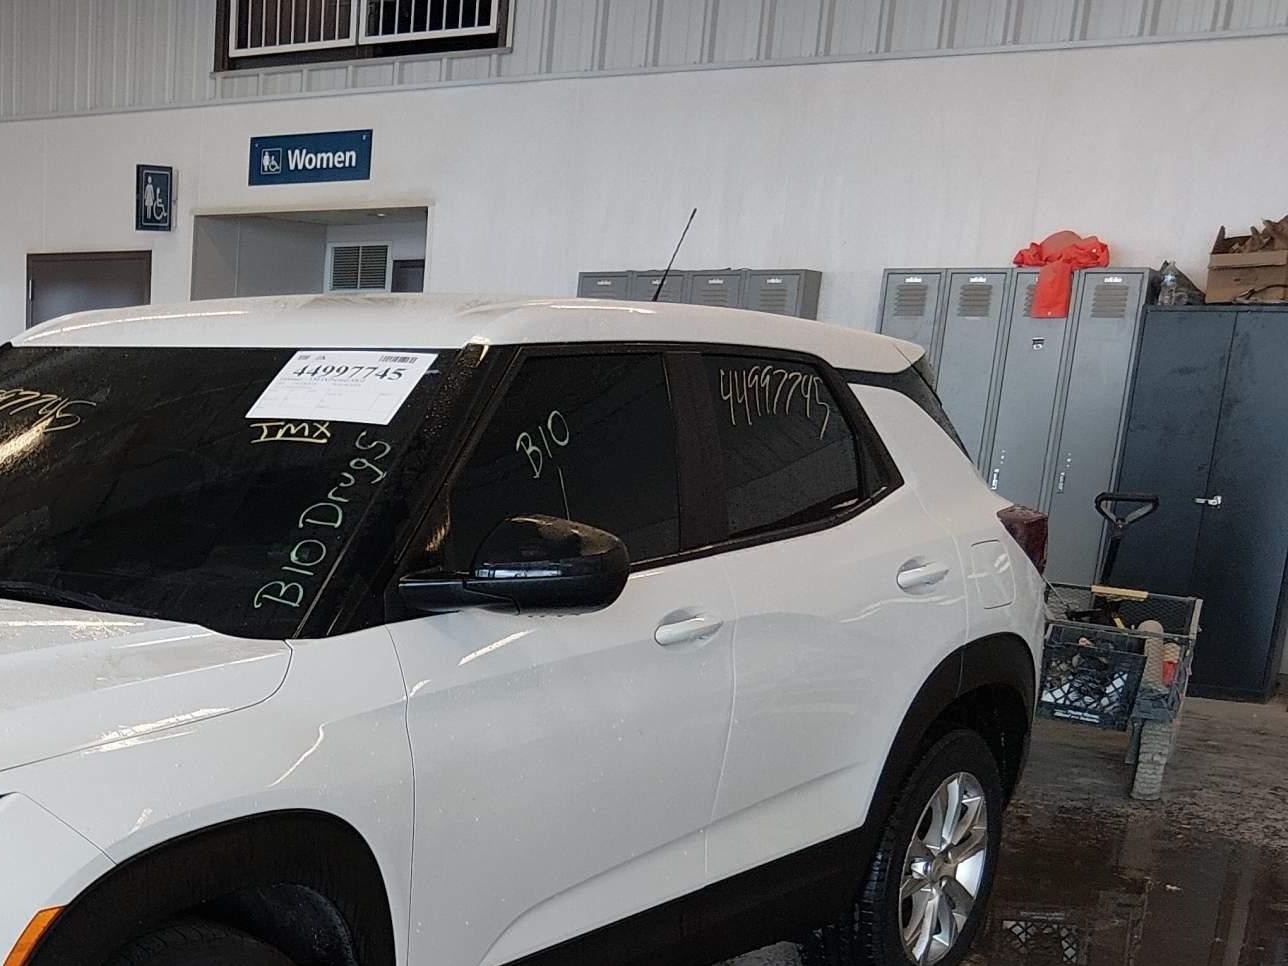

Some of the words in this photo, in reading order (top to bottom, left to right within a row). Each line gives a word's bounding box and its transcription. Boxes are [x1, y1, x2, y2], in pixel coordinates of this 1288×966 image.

[288, 149, 356, 170] Women
[293, 364, 407, 382] 44997745
[719, 365, 830, 441] 44997745
